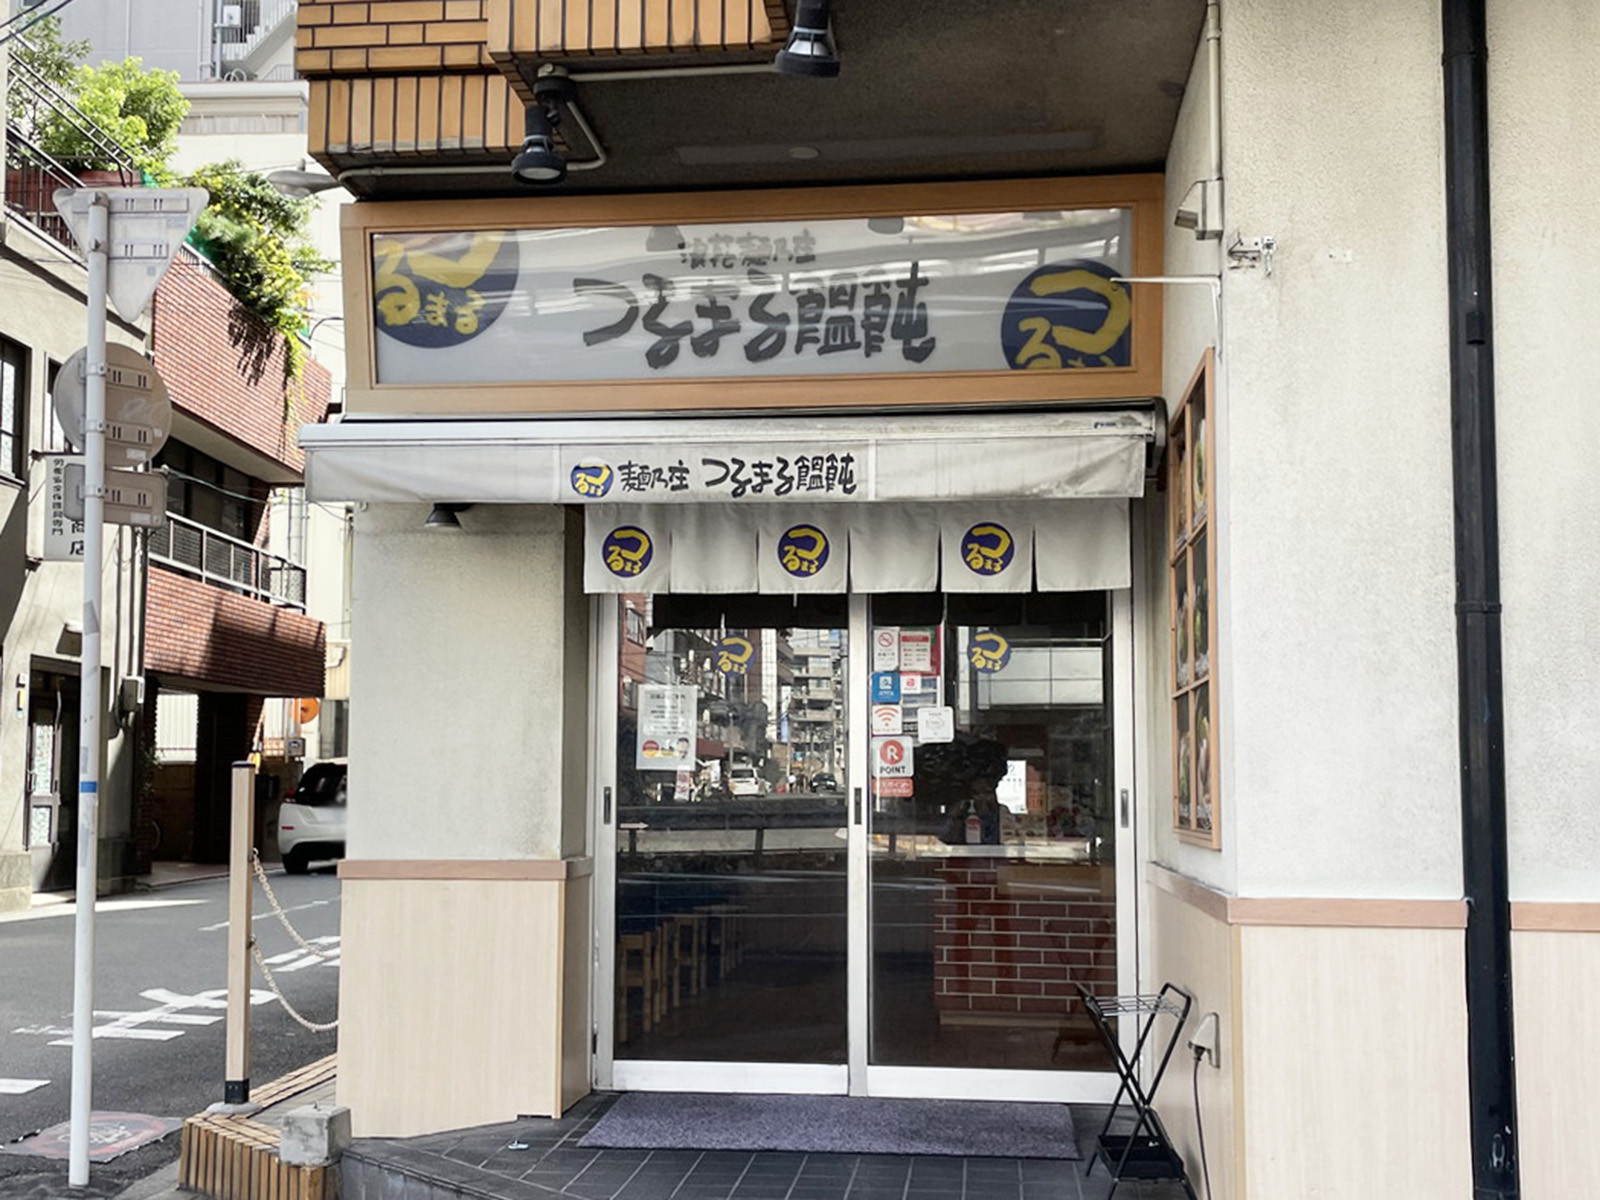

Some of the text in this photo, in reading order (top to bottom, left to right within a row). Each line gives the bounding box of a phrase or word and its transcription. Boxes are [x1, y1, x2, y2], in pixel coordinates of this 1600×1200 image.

[573, 261, 936, 369] つるまる饂飩
[617, 452, 857, 498] 麺乃庄 つるまる饂飩
[879, 766, 906, 774] POINT
